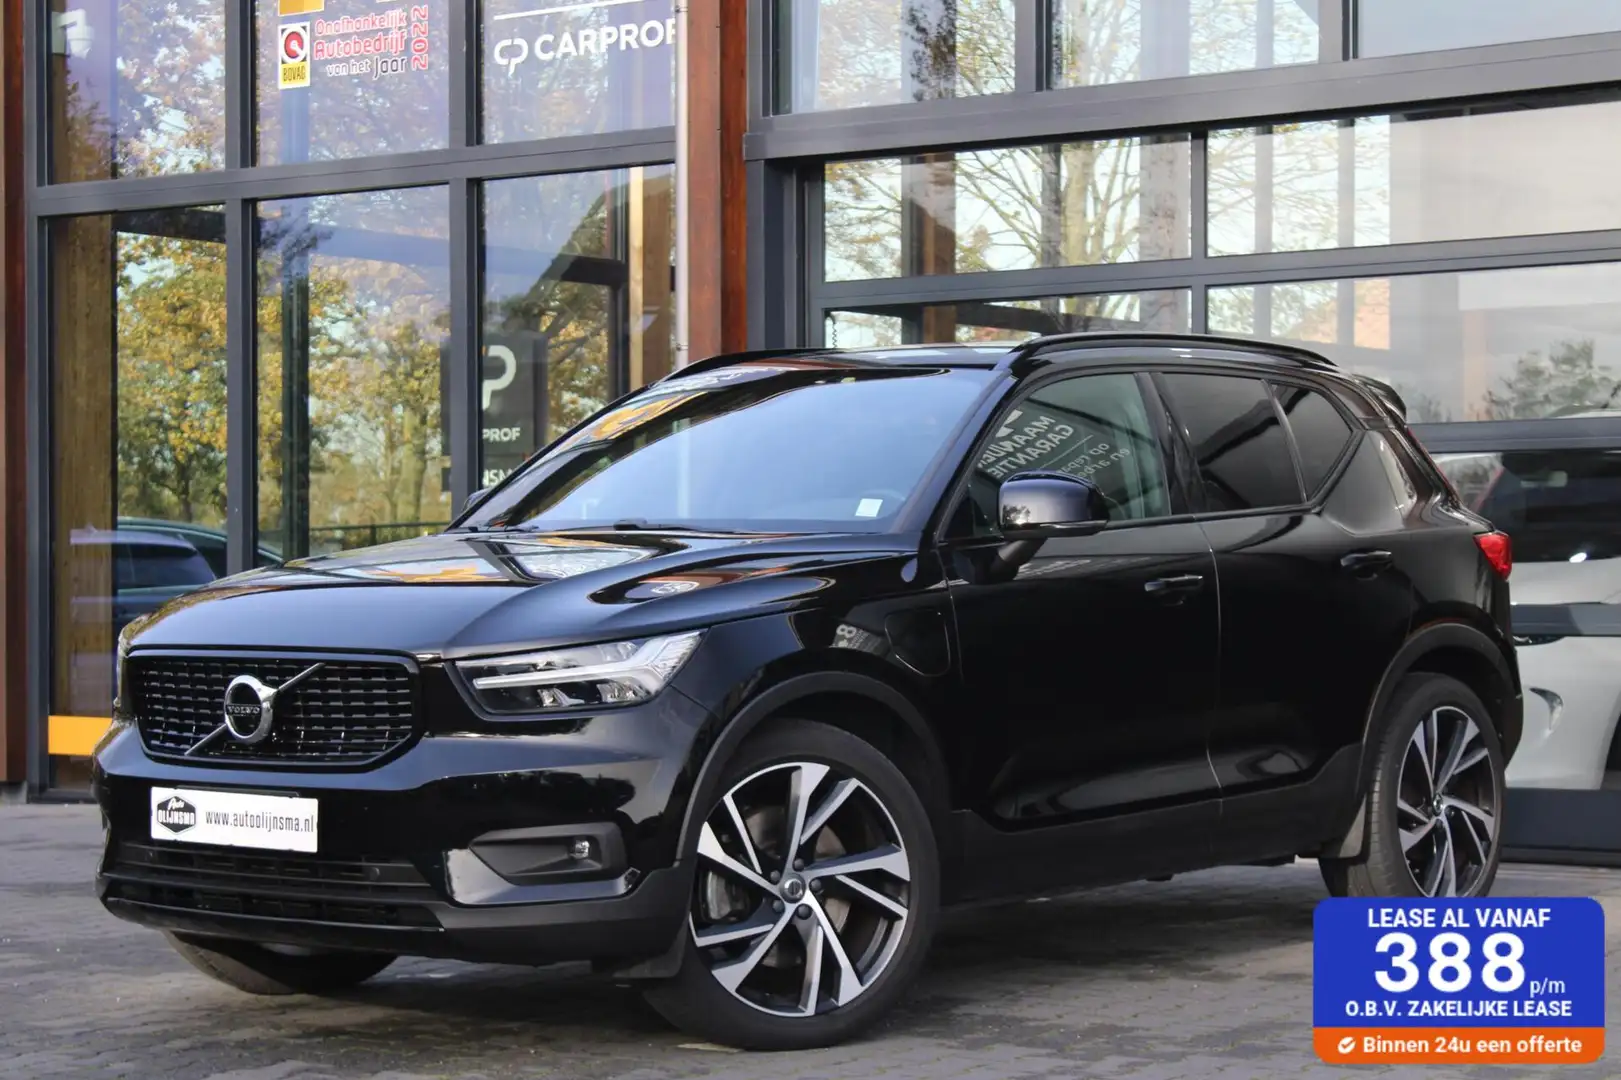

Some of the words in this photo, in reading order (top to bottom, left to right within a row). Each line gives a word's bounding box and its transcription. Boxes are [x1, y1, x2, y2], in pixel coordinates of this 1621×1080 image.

[315, 9, 406, 36] Onafhankelijk
[314, 28, 407, 59] Autobedrijf
[411, 5, 428, 70] 2022
[283, 66, 306, 82] BOVAG
[327, 63, 348, 76] van
[350, 59, 370, 74] het
[227, 705, 260, 714] VOLVO
[167, 797, 185, 811] Auto
[205, 810, 314, 833] www.autoolijnsma.nl
